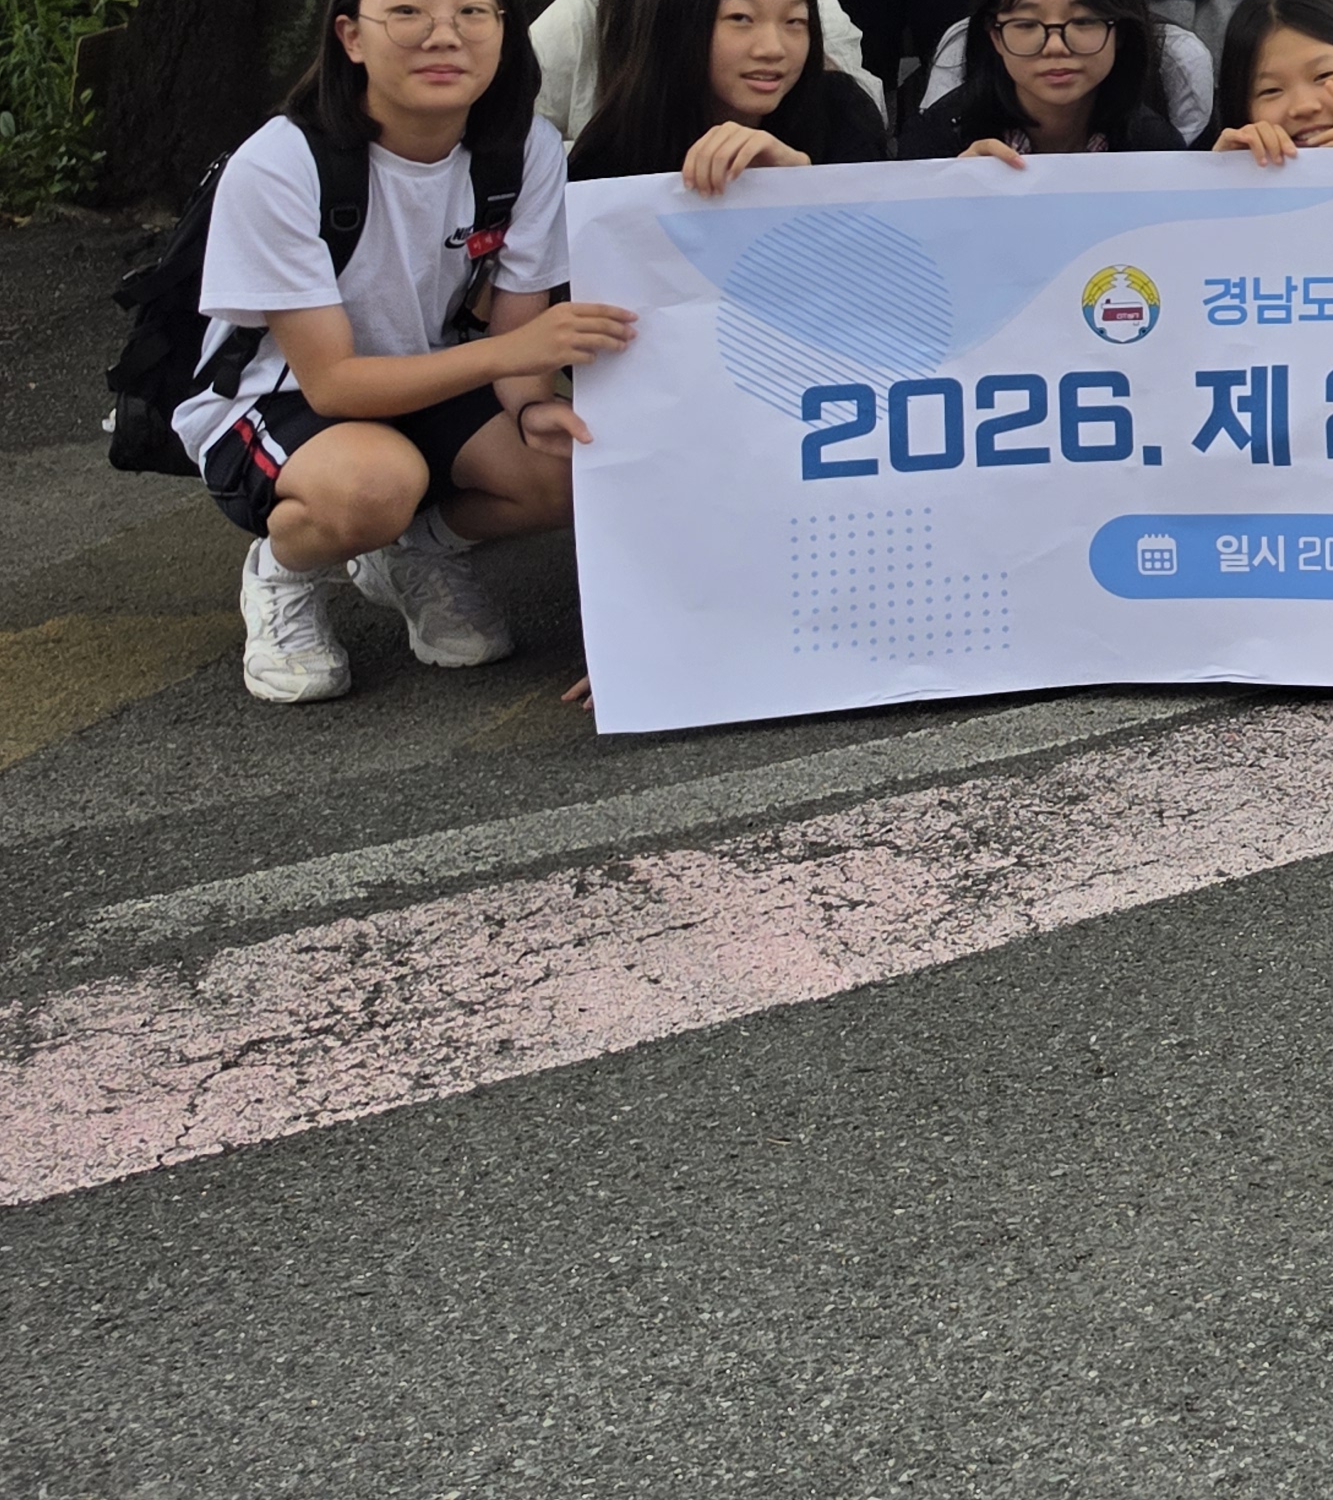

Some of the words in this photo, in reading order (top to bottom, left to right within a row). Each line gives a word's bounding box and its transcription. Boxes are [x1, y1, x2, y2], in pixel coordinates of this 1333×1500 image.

[801, 370, 1162, 481] 2026.
[1191, 365, 1291, 466] 제
[1215, 534, 1286, 572] 일시
